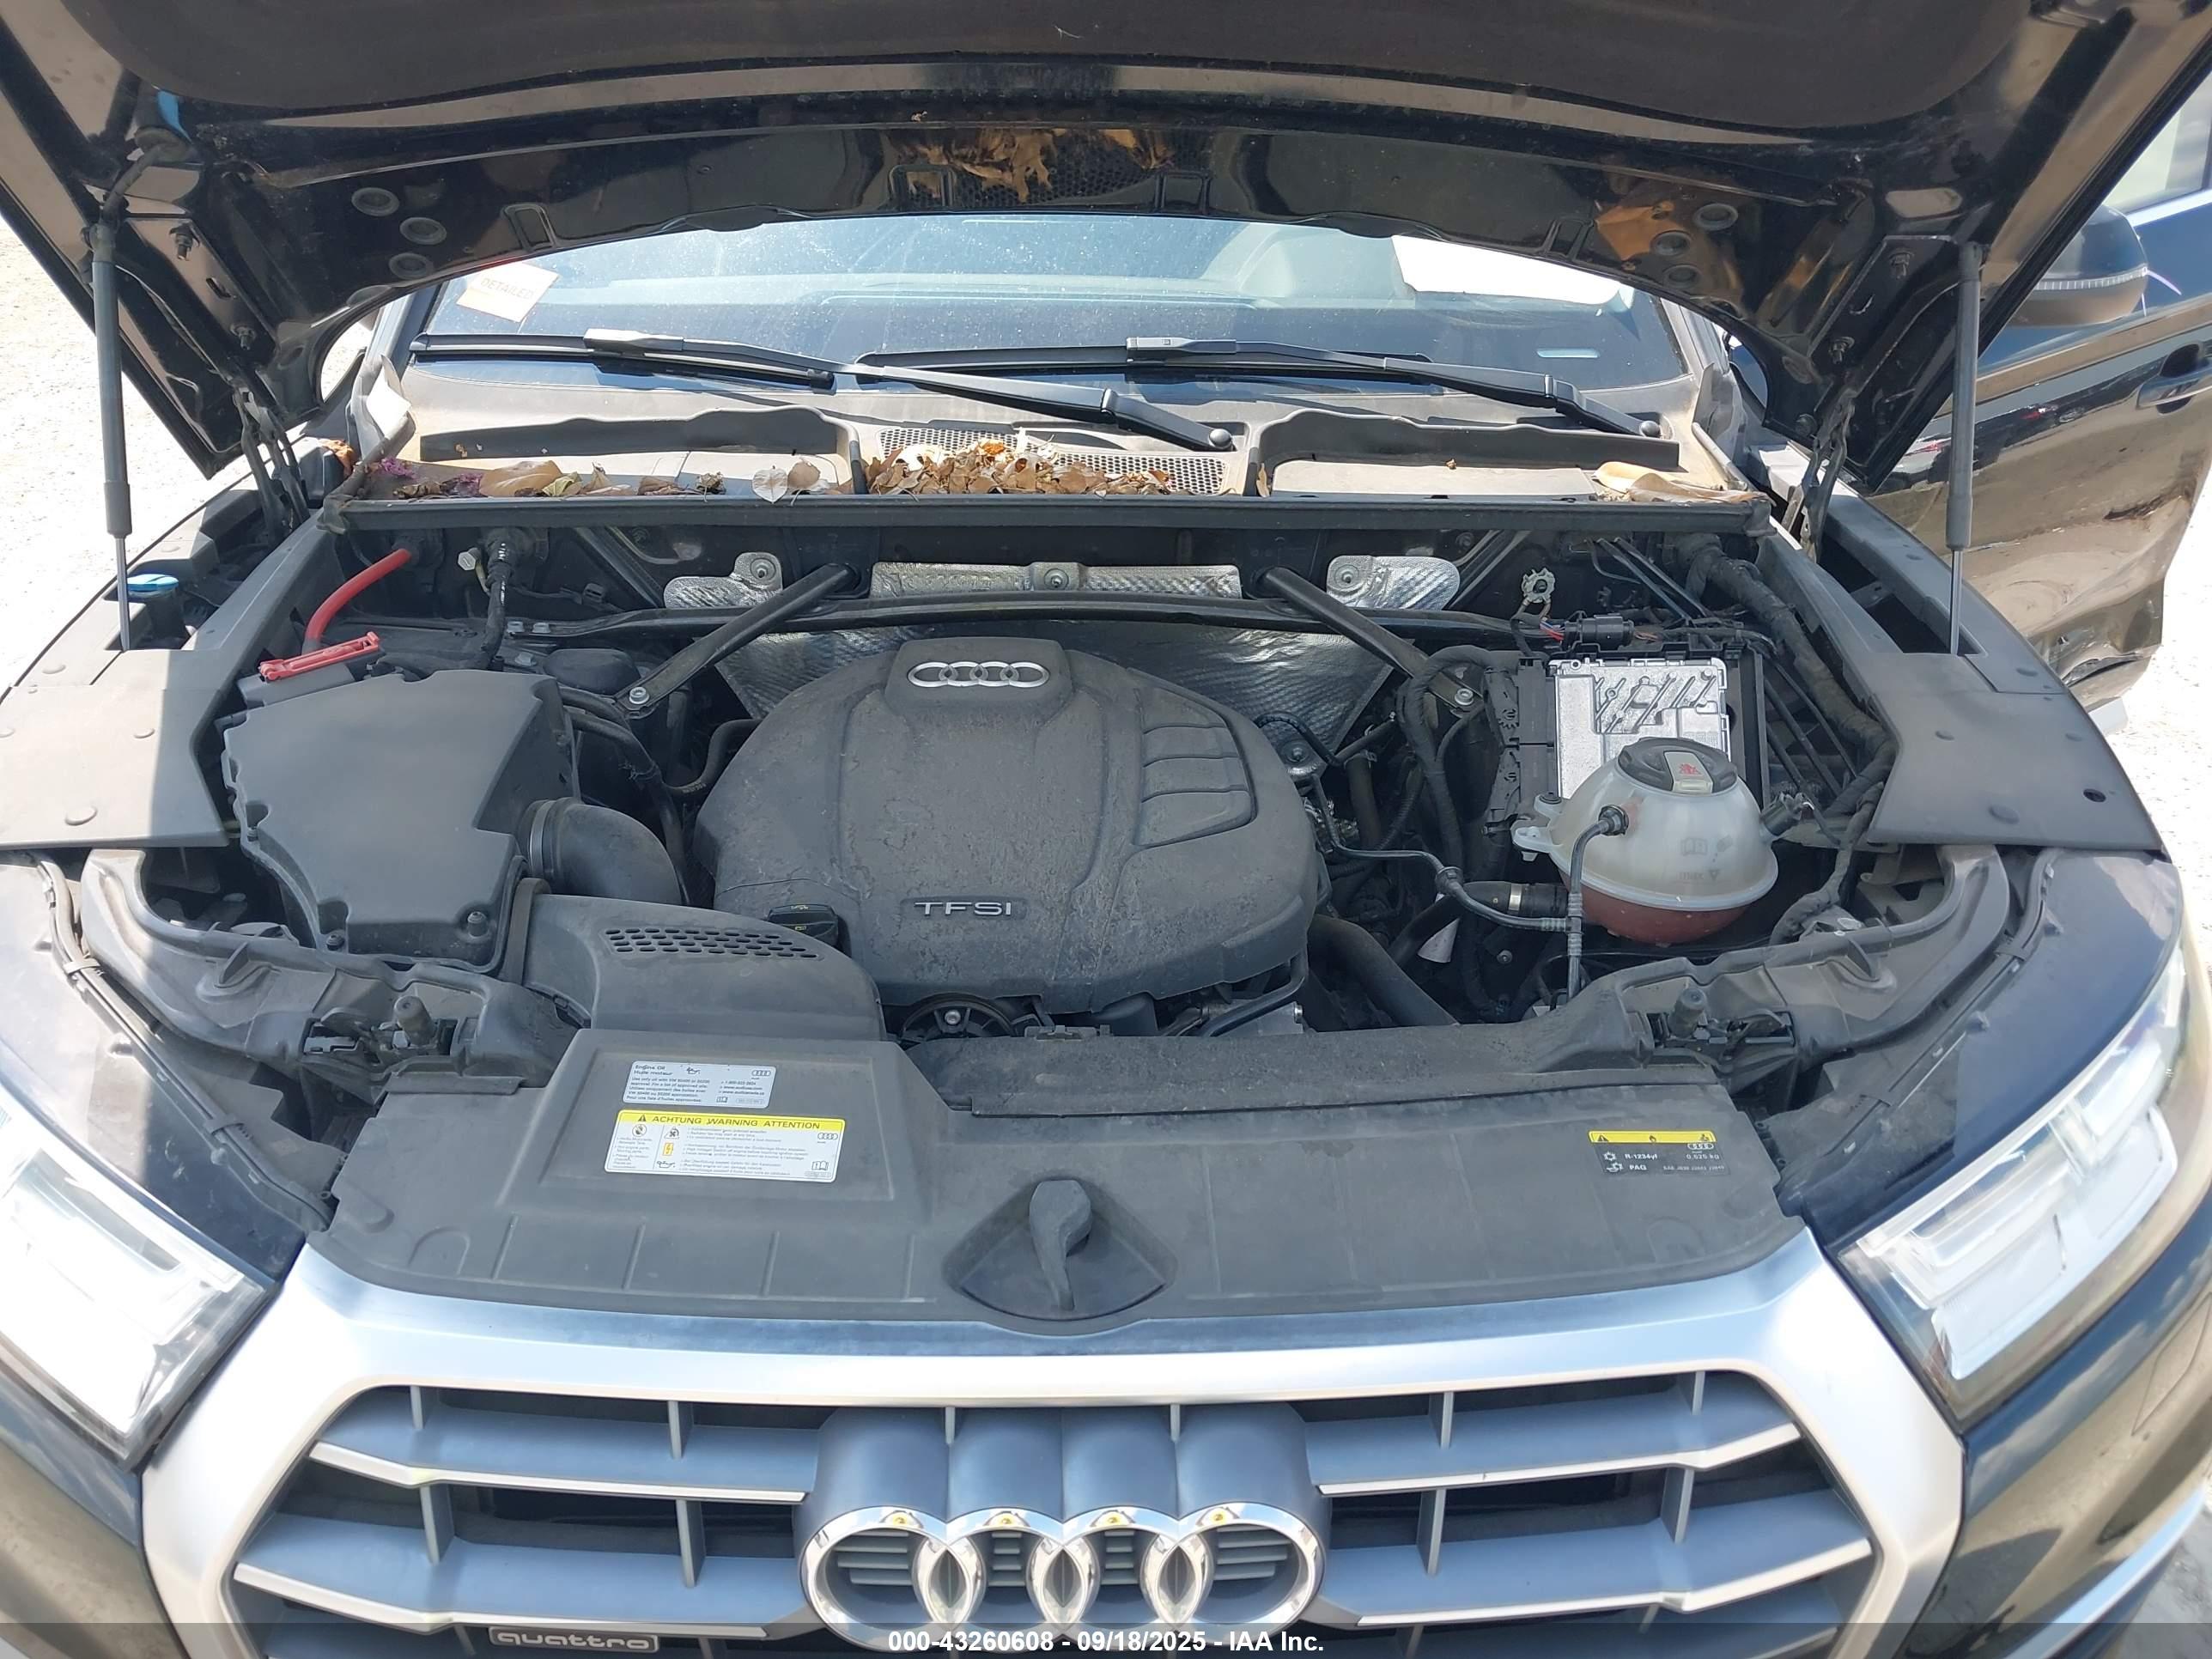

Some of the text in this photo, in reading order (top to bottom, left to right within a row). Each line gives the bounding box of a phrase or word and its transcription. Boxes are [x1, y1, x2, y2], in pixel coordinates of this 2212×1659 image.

[914, 902, 1012, 915] TFSI
[652, 1115, 820, 1129] ACHTUNG WARNING ATTENTION
[497, 1632, 649, 1650] quattro
